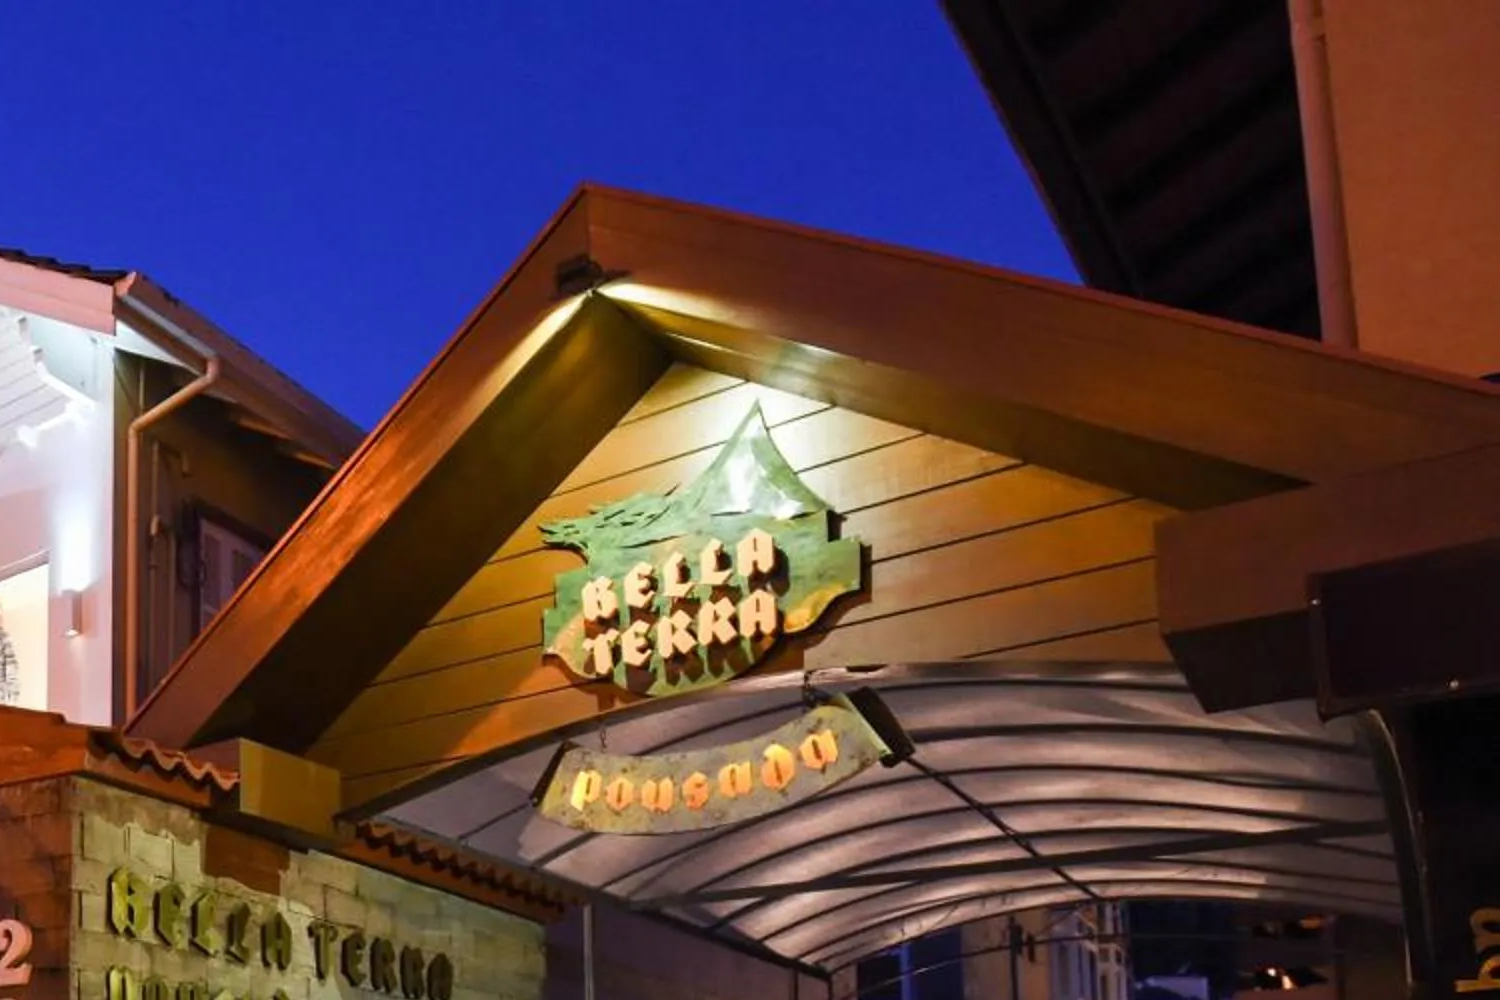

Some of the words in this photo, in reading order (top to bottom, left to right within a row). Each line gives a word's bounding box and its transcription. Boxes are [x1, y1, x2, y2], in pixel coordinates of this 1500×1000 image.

[582, 528, 775, 622] BELLA
[583, 588, 777, 675] TERRA
[106, 866, 292, 972] BELLA
